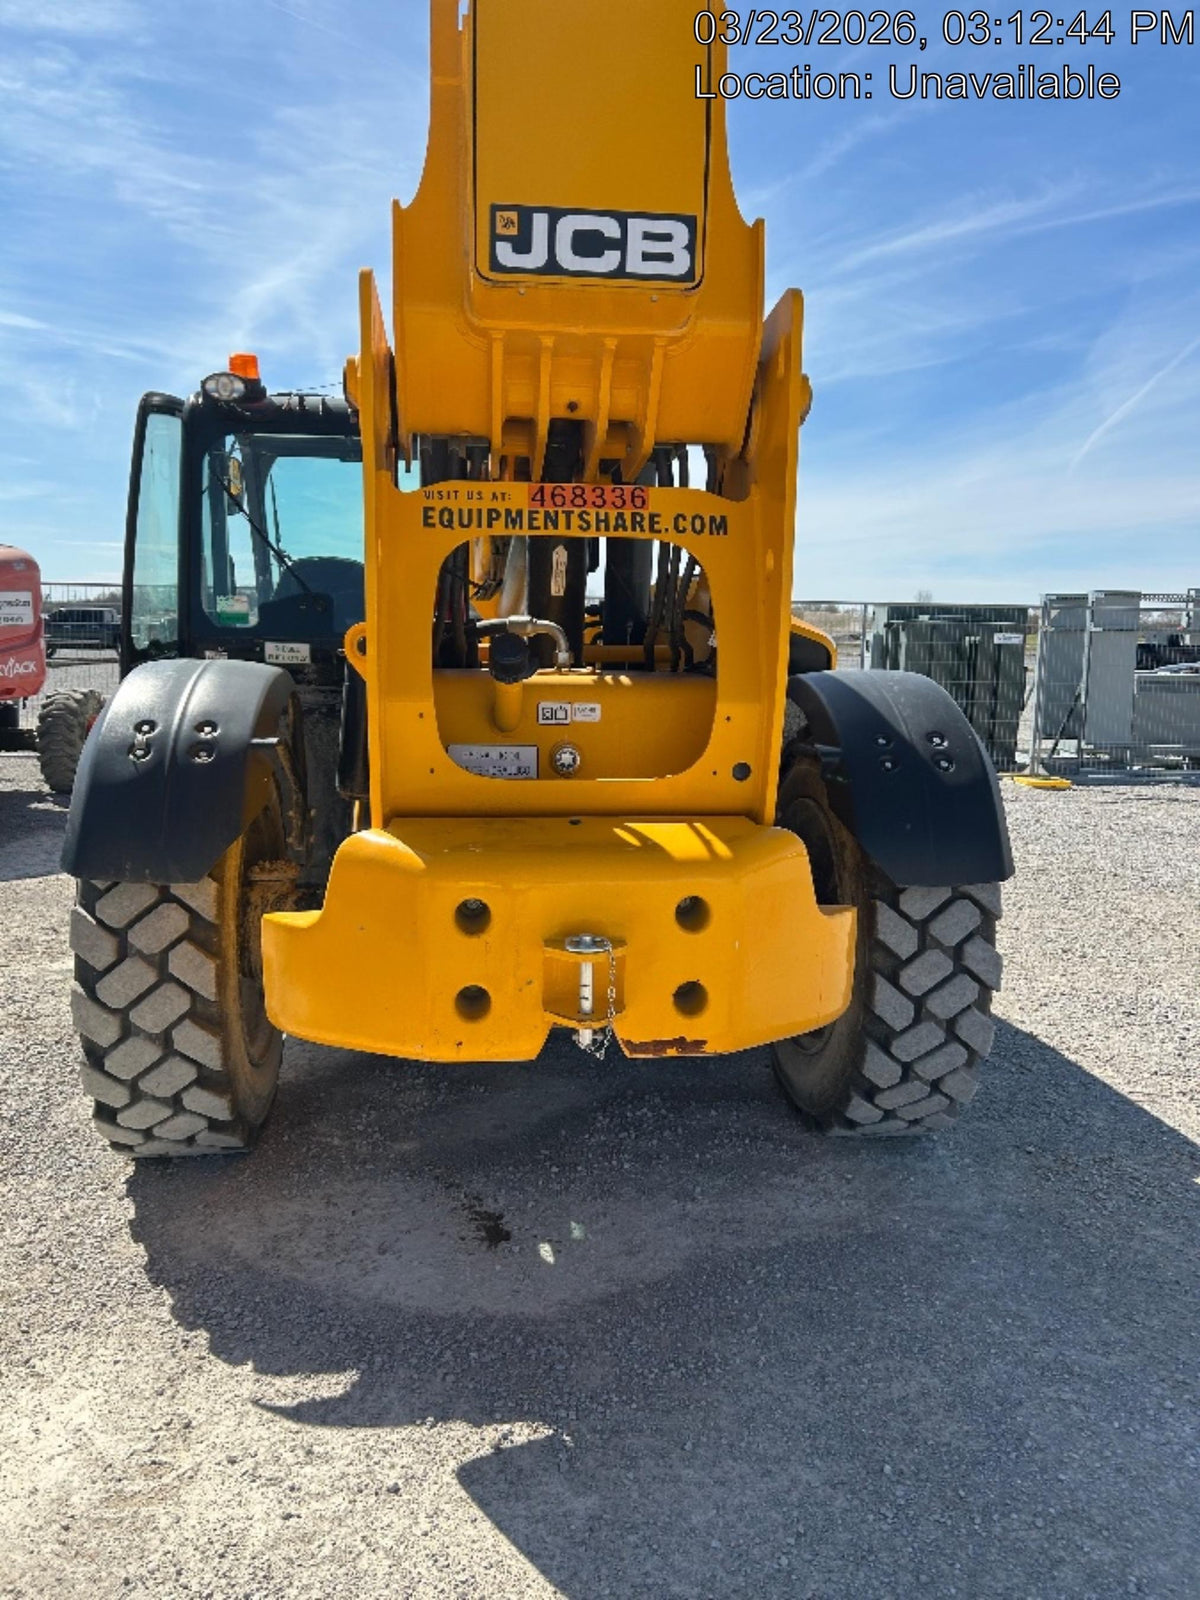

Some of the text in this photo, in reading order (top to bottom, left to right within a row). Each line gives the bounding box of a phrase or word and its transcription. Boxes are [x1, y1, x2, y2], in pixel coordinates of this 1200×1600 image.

[495, 212, 691, 276] JCB
[423, 490, 511, 502] VISIT US AT:
[531, 484, 648, 509] 468336
[422, 506, 729, 536] EQUIPMENTSHARE.COM
